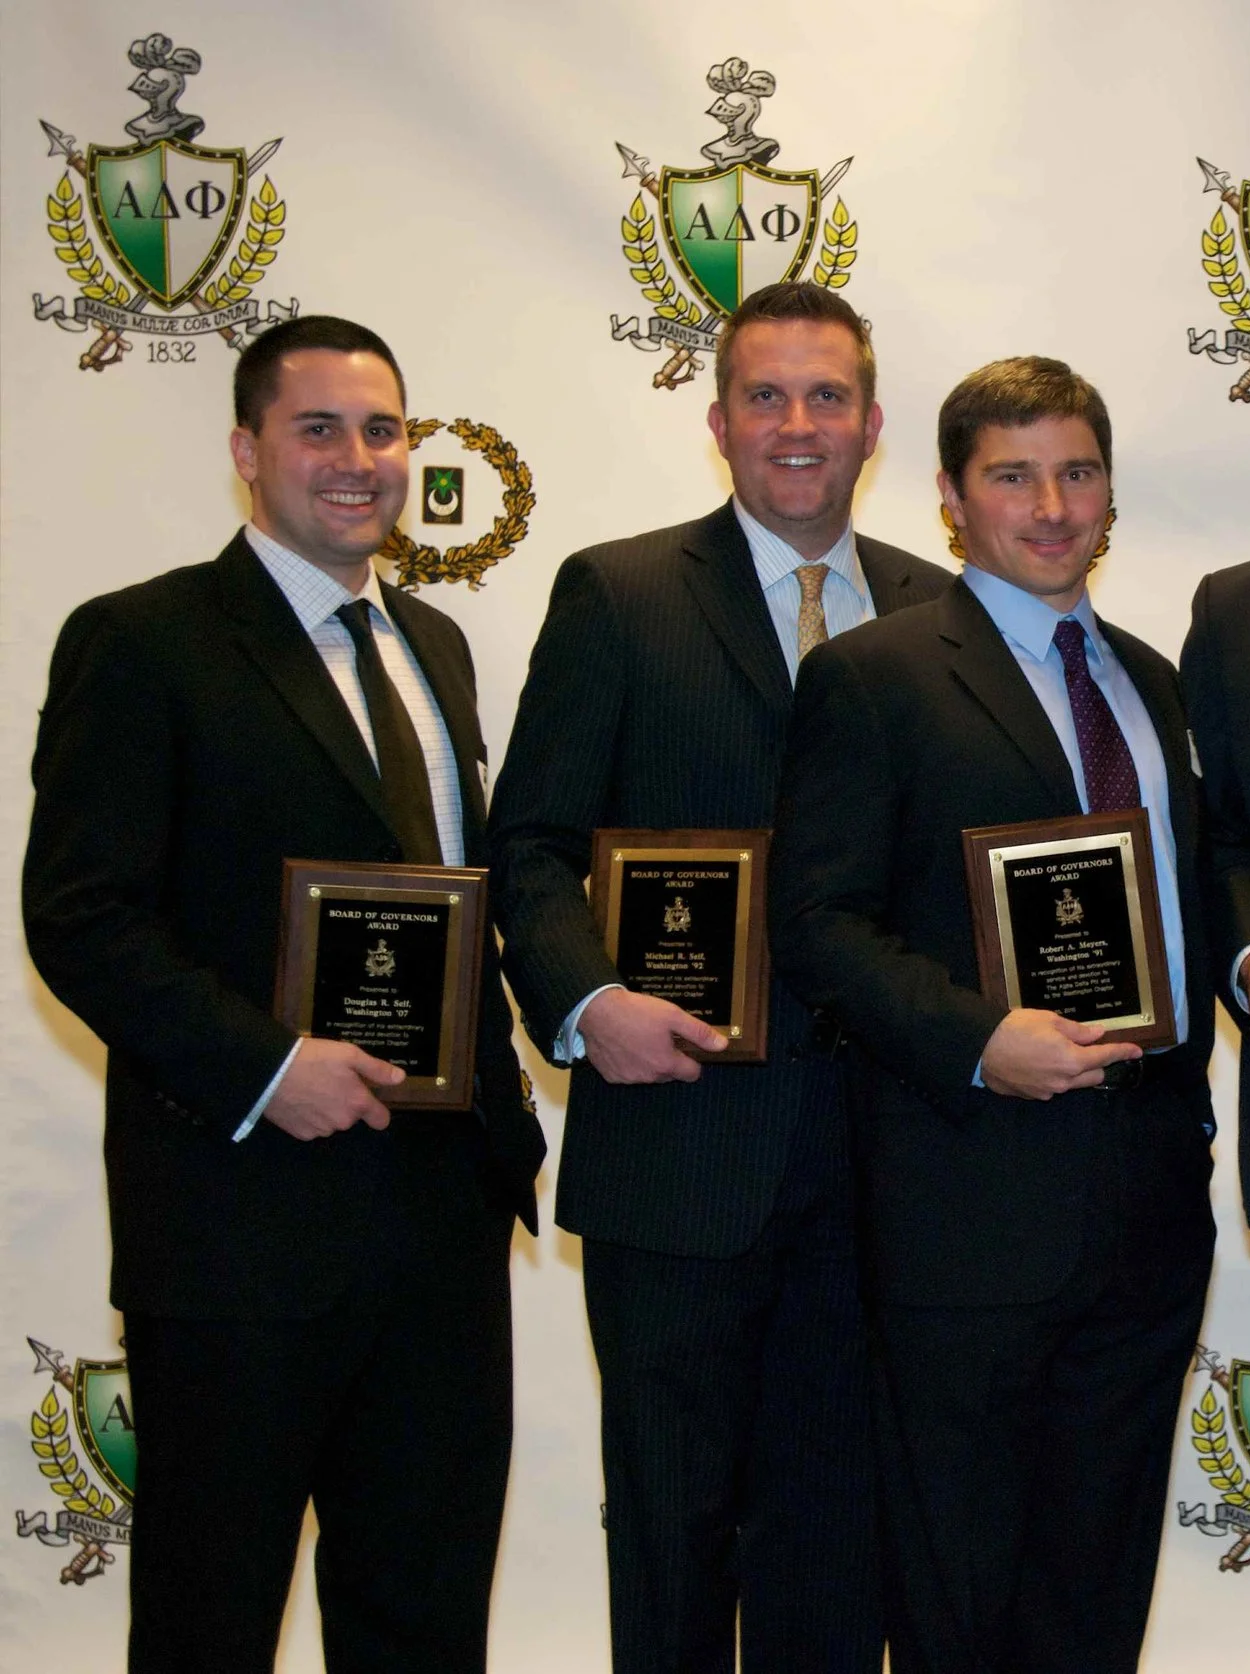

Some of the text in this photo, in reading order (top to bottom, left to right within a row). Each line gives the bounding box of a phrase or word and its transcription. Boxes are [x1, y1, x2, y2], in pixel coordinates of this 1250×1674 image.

[84, 301, 128, 325] MANUS
[183, 317, 211, 331] COR
[214, 302, 249, 326] UNUM
[658, 320, 700, 345] MANUS
[147, 341, 197, 363] 1832
[1013, 858, 1113, 878] BOARD OF GOVERNORS
[631, 871, 729, 879] BOARD OF GOVERNORS
[1050, 872, 1079, 883] AWARD
[329, 909, 438, 923] BOARD OF GOVERNORS
[367, 922, 399, 931] AWARD
[1039, 945, 1064, 955] Robert
[645, 952, 674, 960] Michael
[1046, 952, 1090, 963] Washington
[646, 961, 689, 970] Washington
[344, 997, 378, 1007] Douglas
[381, 999, 390, 1007] R.
[345, 1007, 392, 1018] Washington
[67, 1512, 110, 1538] MANUS
